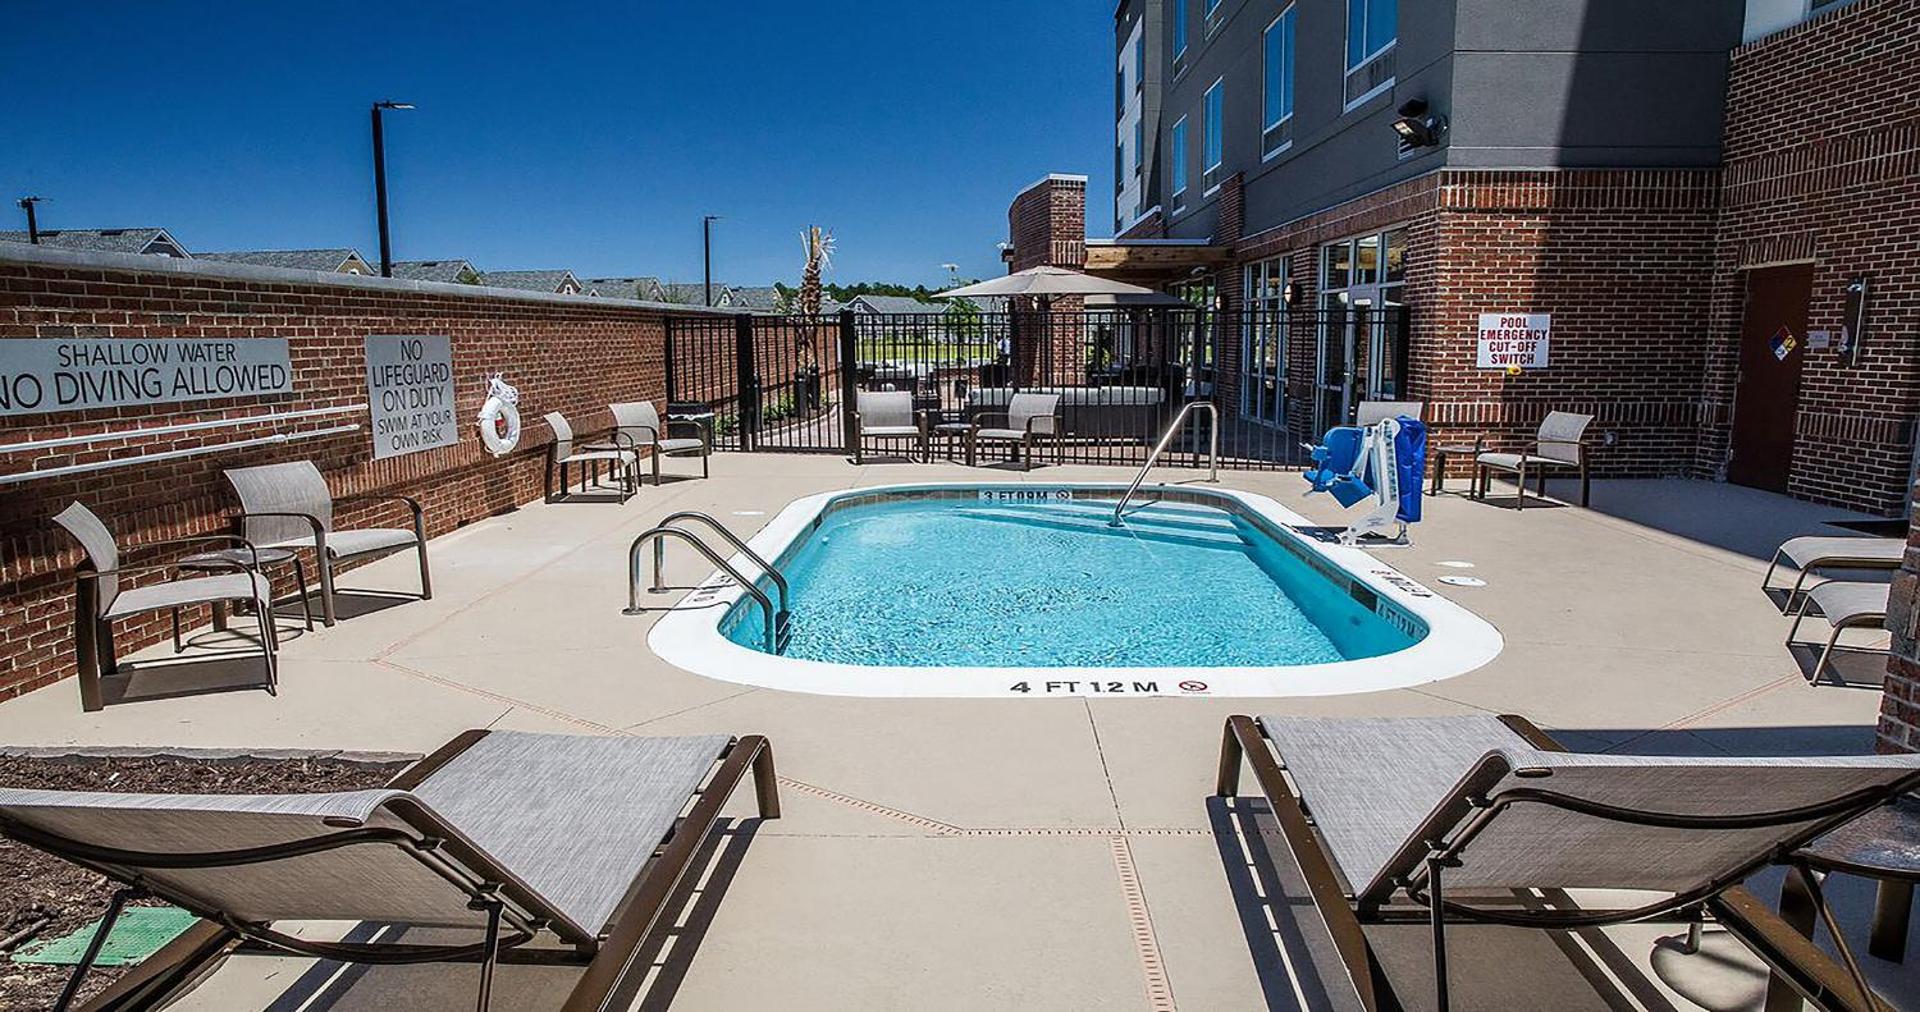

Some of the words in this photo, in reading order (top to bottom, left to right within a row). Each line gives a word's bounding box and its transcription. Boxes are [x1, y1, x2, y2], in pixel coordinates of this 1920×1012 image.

[1500, 317, 1528, 328] POOL
[1480, 329, 1547, 340] EMERGENCY
[57, 343, 169, 367] SHALLOW
[177, 342, 237, 362] WATER
[401, 339, 422, 361] NO
[1489, 341, 1537, 352] CUT-OFF
[1491, 353, 1534, 364] SWITCH
[54, 367, 163, 405] DIVING
[172, 364, 287, 397] ALLOWED
[372, 363, 449, 388] LIFEGUARD
[383, 389, 406, 412] ON
[409, 386, 444, 409] DUTY
[377, 415, 408, 435] SWIM
[411, 413, 422, 429] AT
[424, 409, 452, 426] YOUR
[392, 431, 419, 450] OWN
[422, 428, 444, 445] RISK
[1010, 681, 1031, 693] 4
[1046, 681, 1080, 693] FT
[1133, 681, 1159, 693] M
